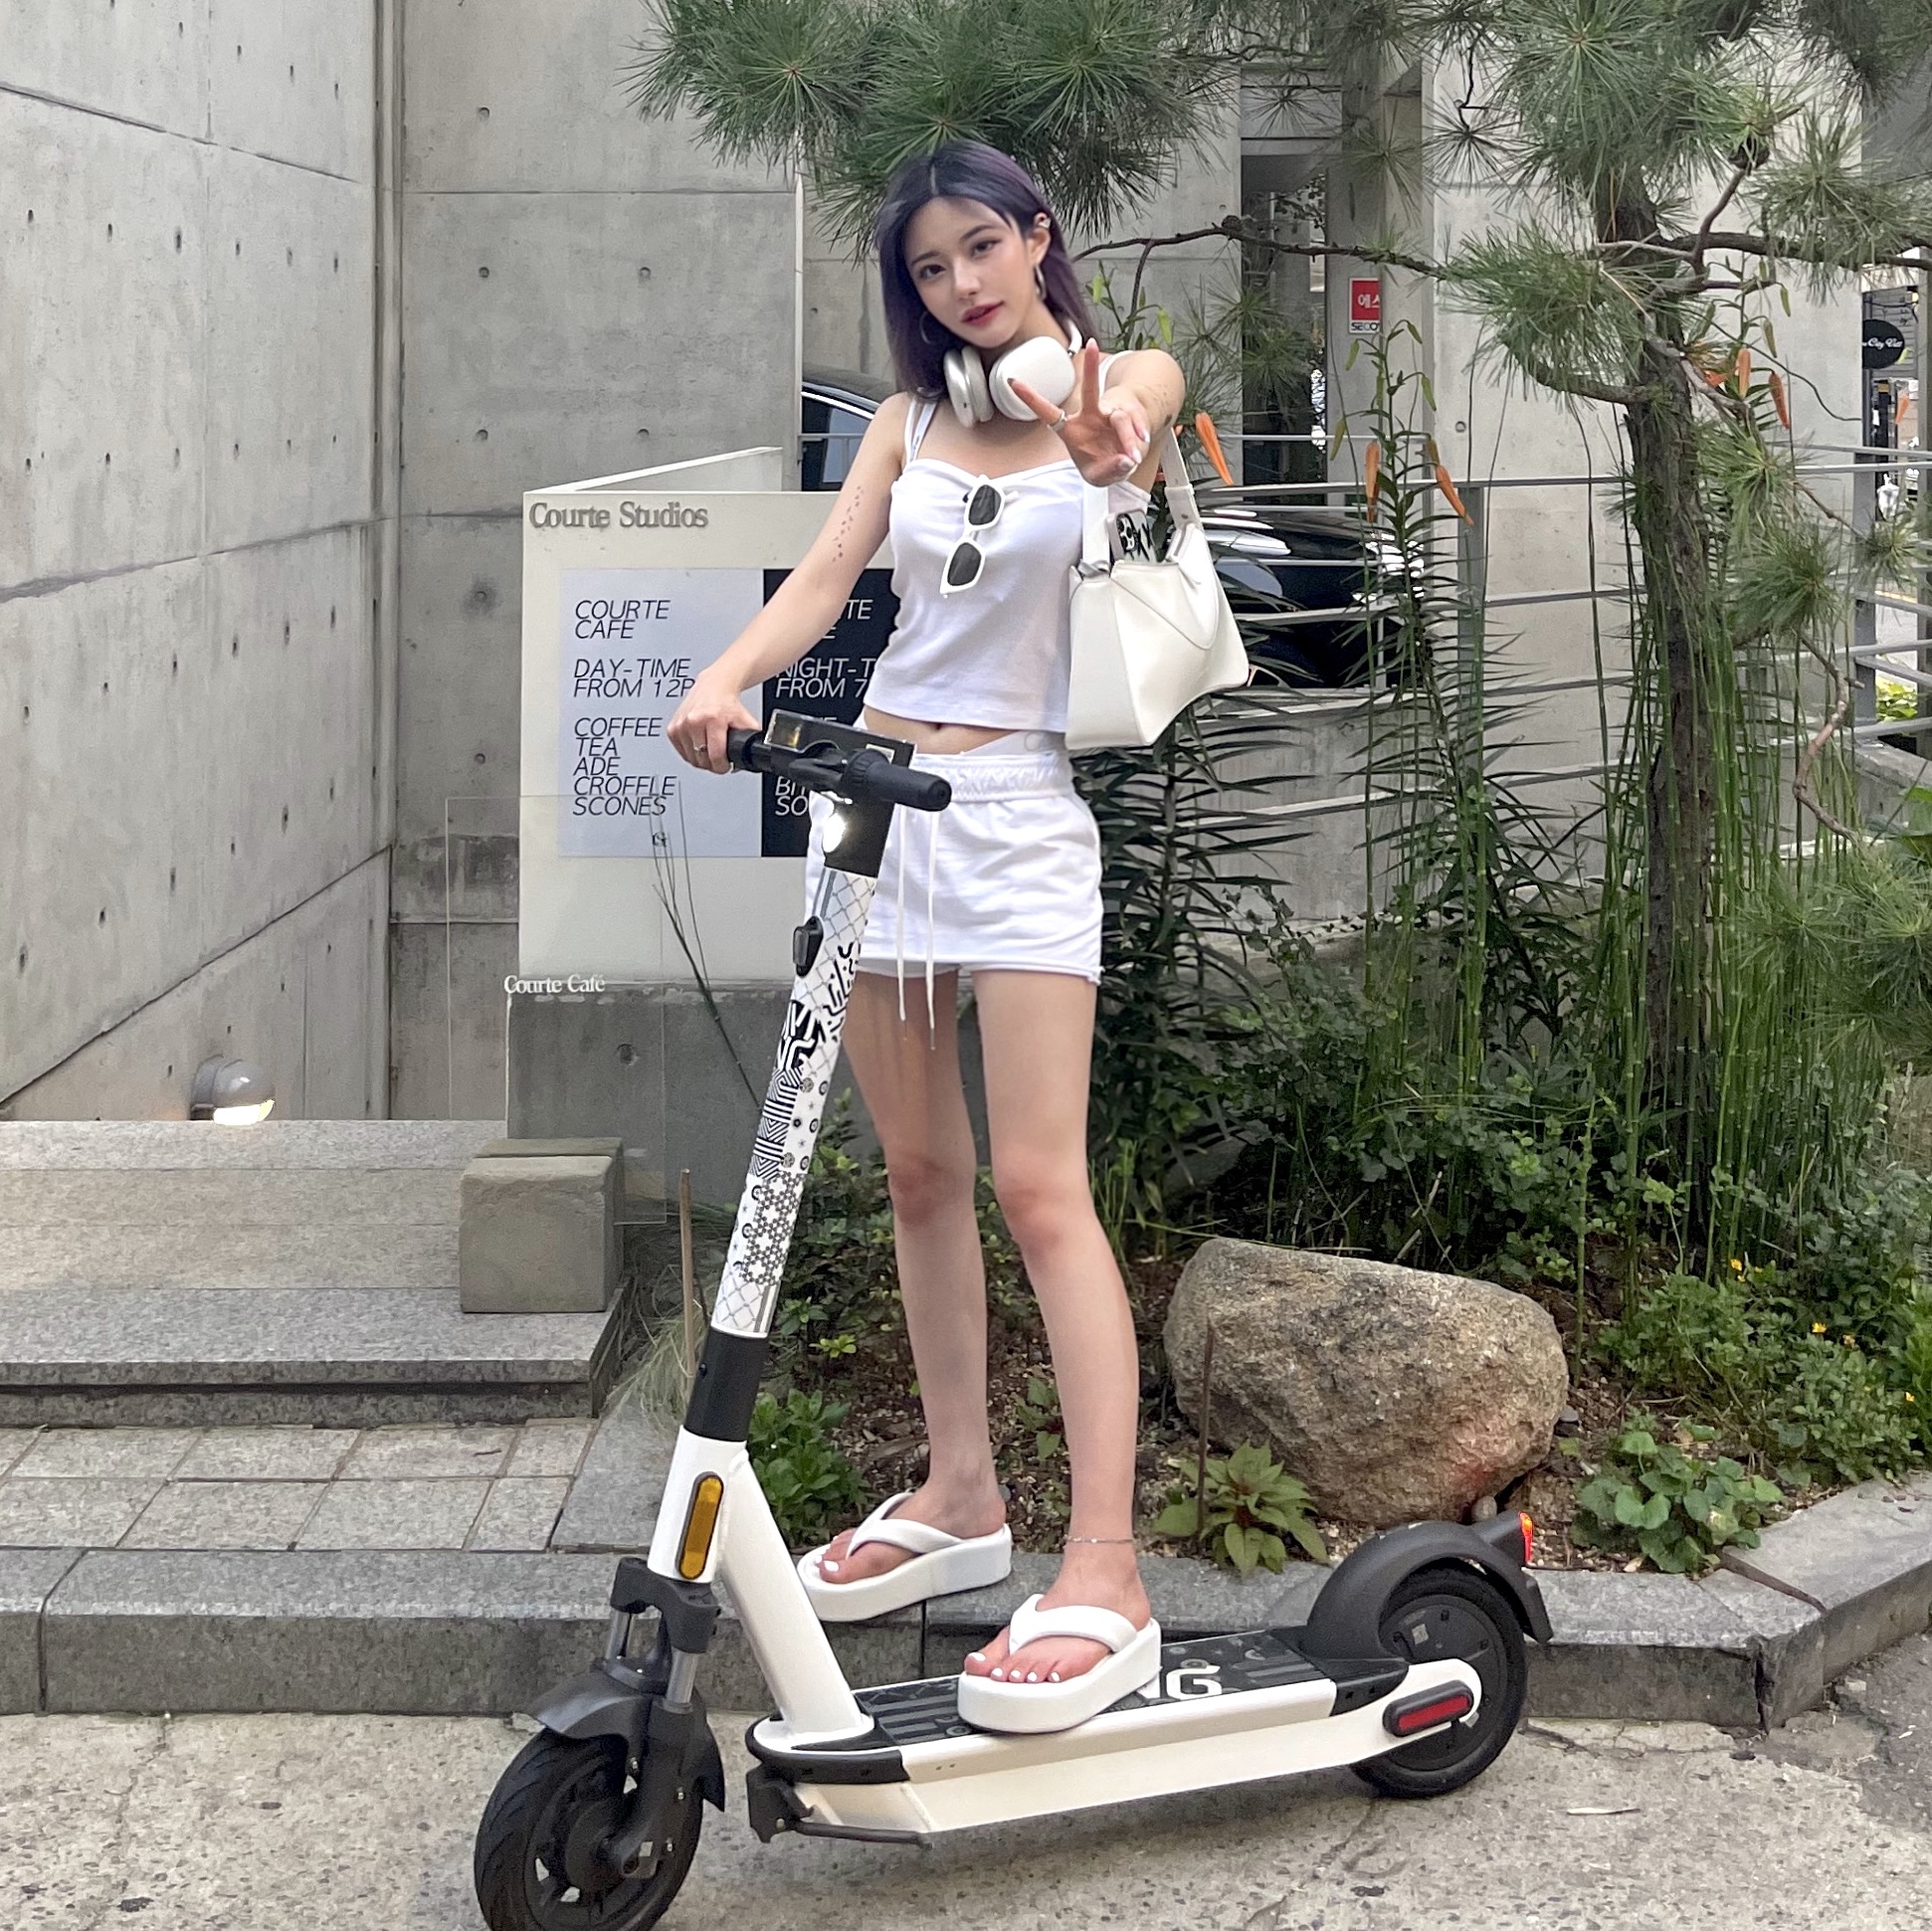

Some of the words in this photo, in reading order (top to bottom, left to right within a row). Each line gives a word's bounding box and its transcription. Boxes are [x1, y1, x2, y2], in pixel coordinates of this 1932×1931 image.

[529, 501, 611, 528] Courte
[620, 500, 708, 528] Studios
[575, 599, 671, 620] COURTE
[575, 619, 636, 639] CAFE
[574, 658, 691, 678] DAY-TIME
[574, 677, 643, 698] FROM
[775, 677, 846, 698] FROM
[574, 716, 664, 737] COFFEE
[576, 736, 618, 757] TEA
[573, 756, 621, 776] ADE
[574, 776, 677, 796] CROFFLE
[572, 796, 667, 816] SCONES
[503, 975, 563, 994] Courte
